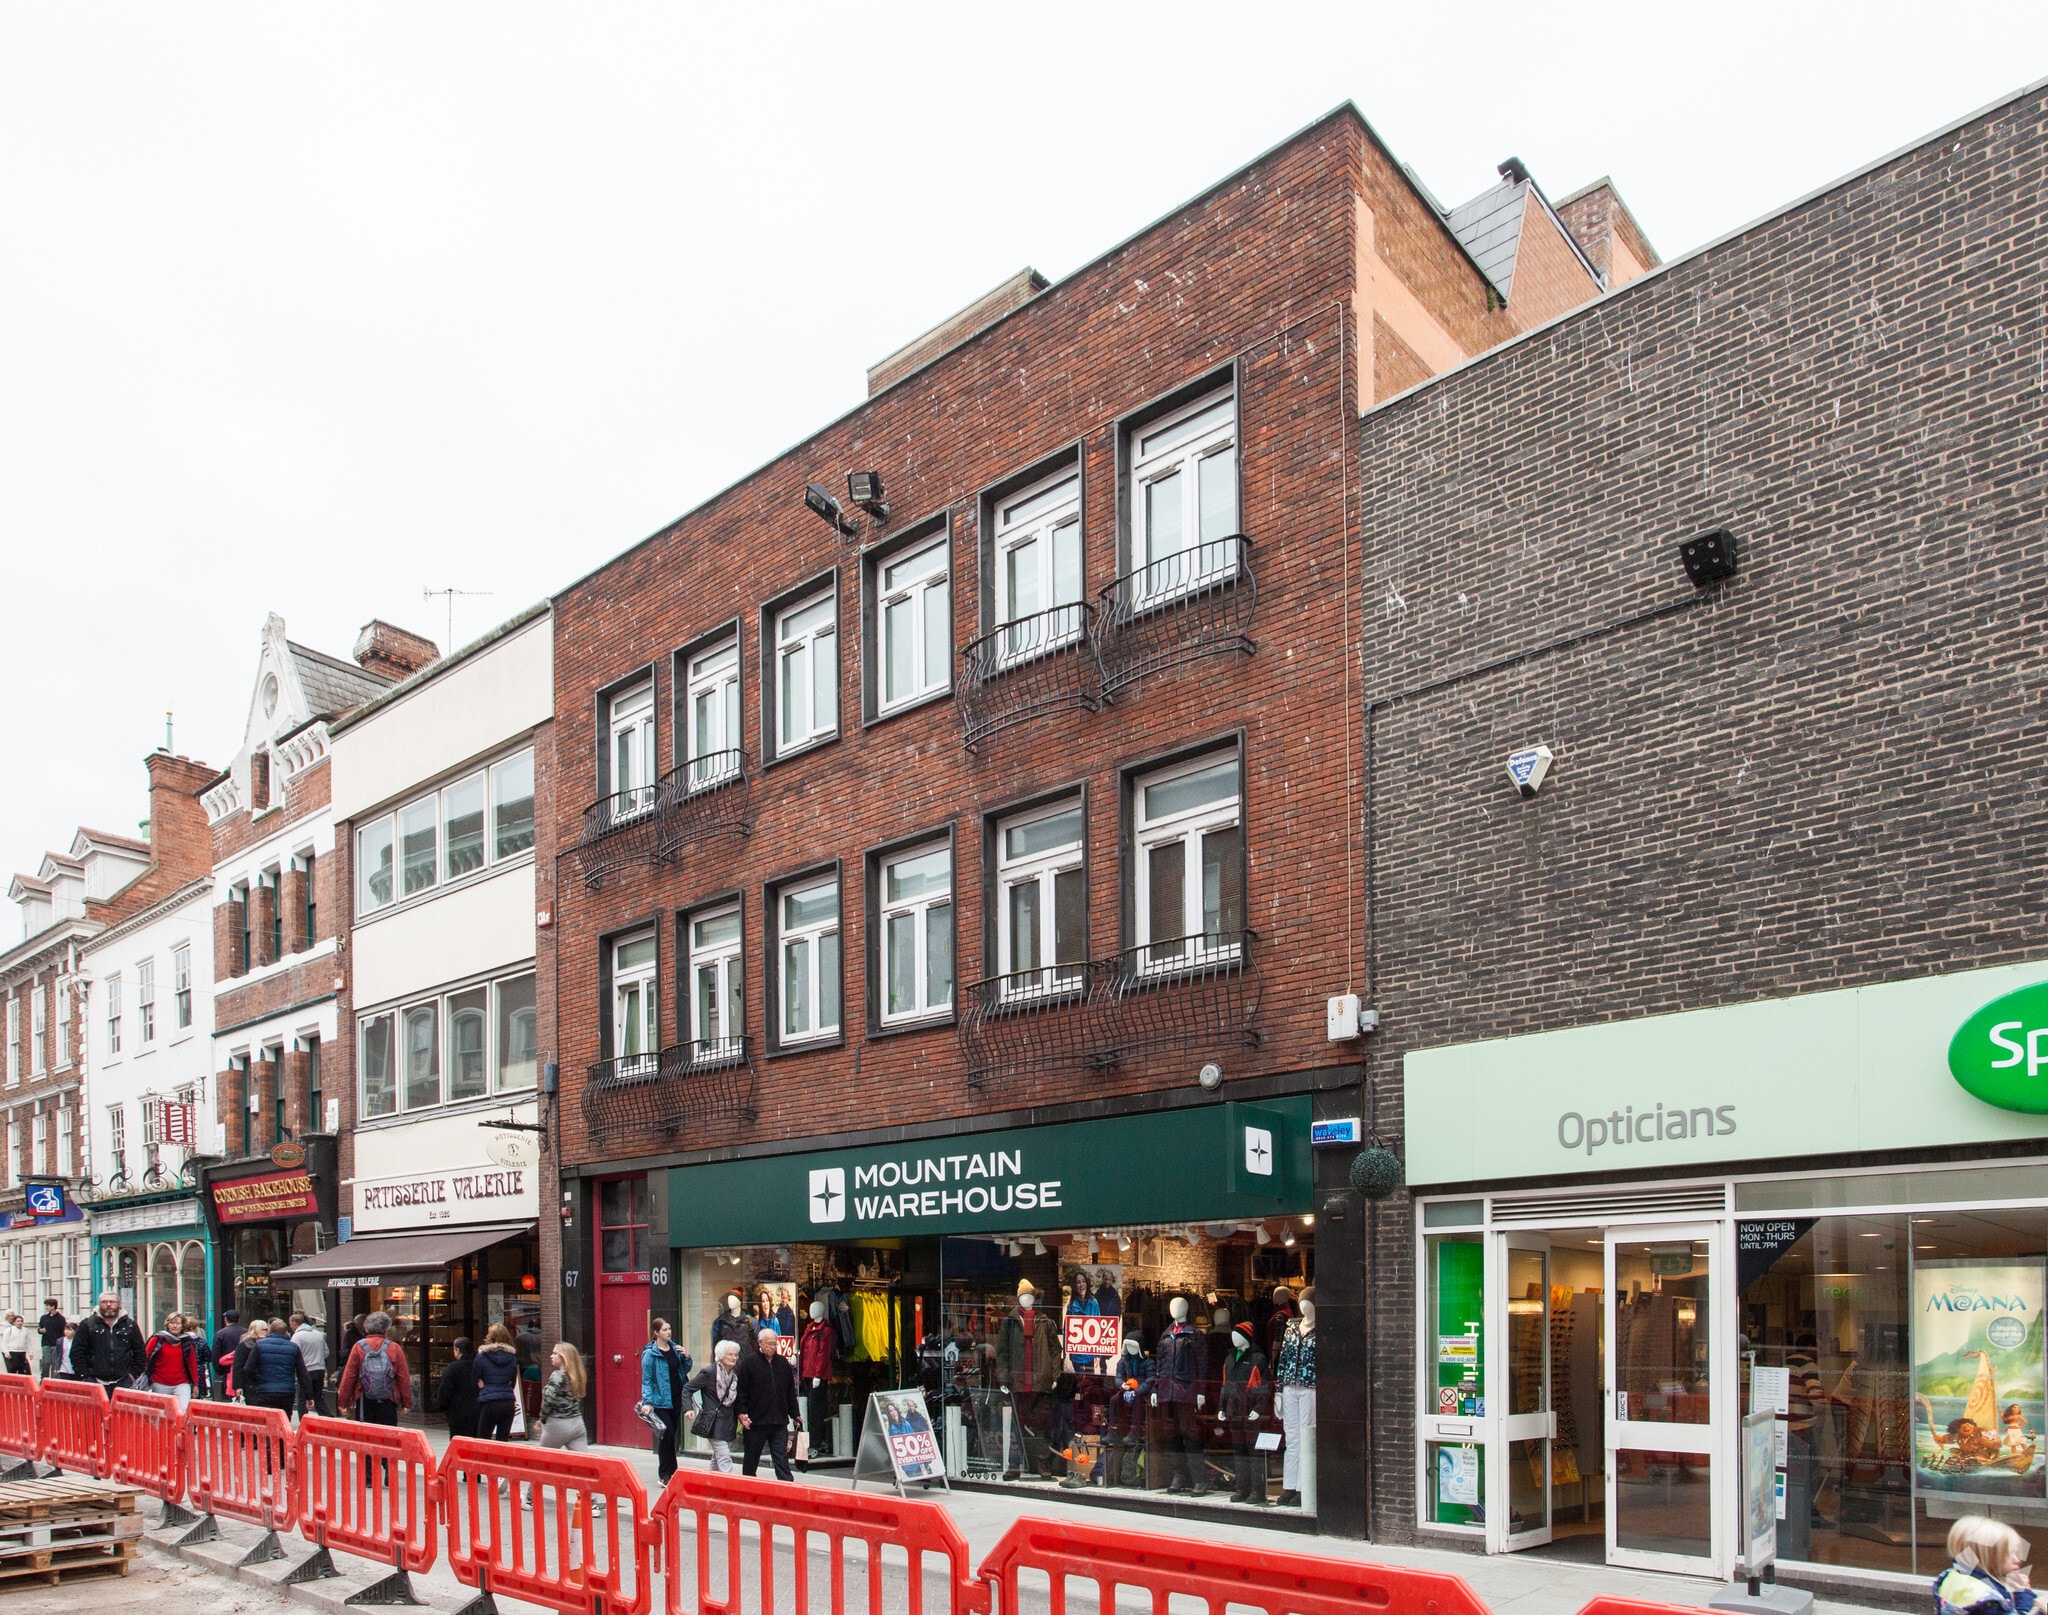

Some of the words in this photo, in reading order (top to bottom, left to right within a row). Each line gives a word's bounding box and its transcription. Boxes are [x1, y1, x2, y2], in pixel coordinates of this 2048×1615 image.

[1510, 755, 1538, 766] Defence
[1989, 1021, 2048, 1077] Sp
[1558, 1102, 1737, 1156] Opticians
[495, 1133, 531, 1146] PATISSERIE
[500, 1158, 527, 1168] VALERIE
[855, 1149, 1021, 1189] MOUNTAIN
[214, 1184, 252, 1204] CORNISH
[252, 1176, 312, 1199] BAKEHOUSE
[364, 1179, 446, 1210] PATISSERIE
[452, 1171, 524, 1200] VALERIE
[854, 1181, 1062, 1220] WAREHOUSE
[1740, 1224, 1765, 1233] NOW
[1766, 1222, 1796, 1232] OPEN
[566, 1270, 578, 1288] 67
[652, 1267, 668, 1285] 66
[1926, 1292, 2027, 1312] MOANA
[1068, 1318, 1116, 1344] 50%
[1067, 1344, 1116, 1354] EVERYTHING
[892, 1434, 930, 1457] 50%
[898, 1454, 935, 1465] EVERYTHING
